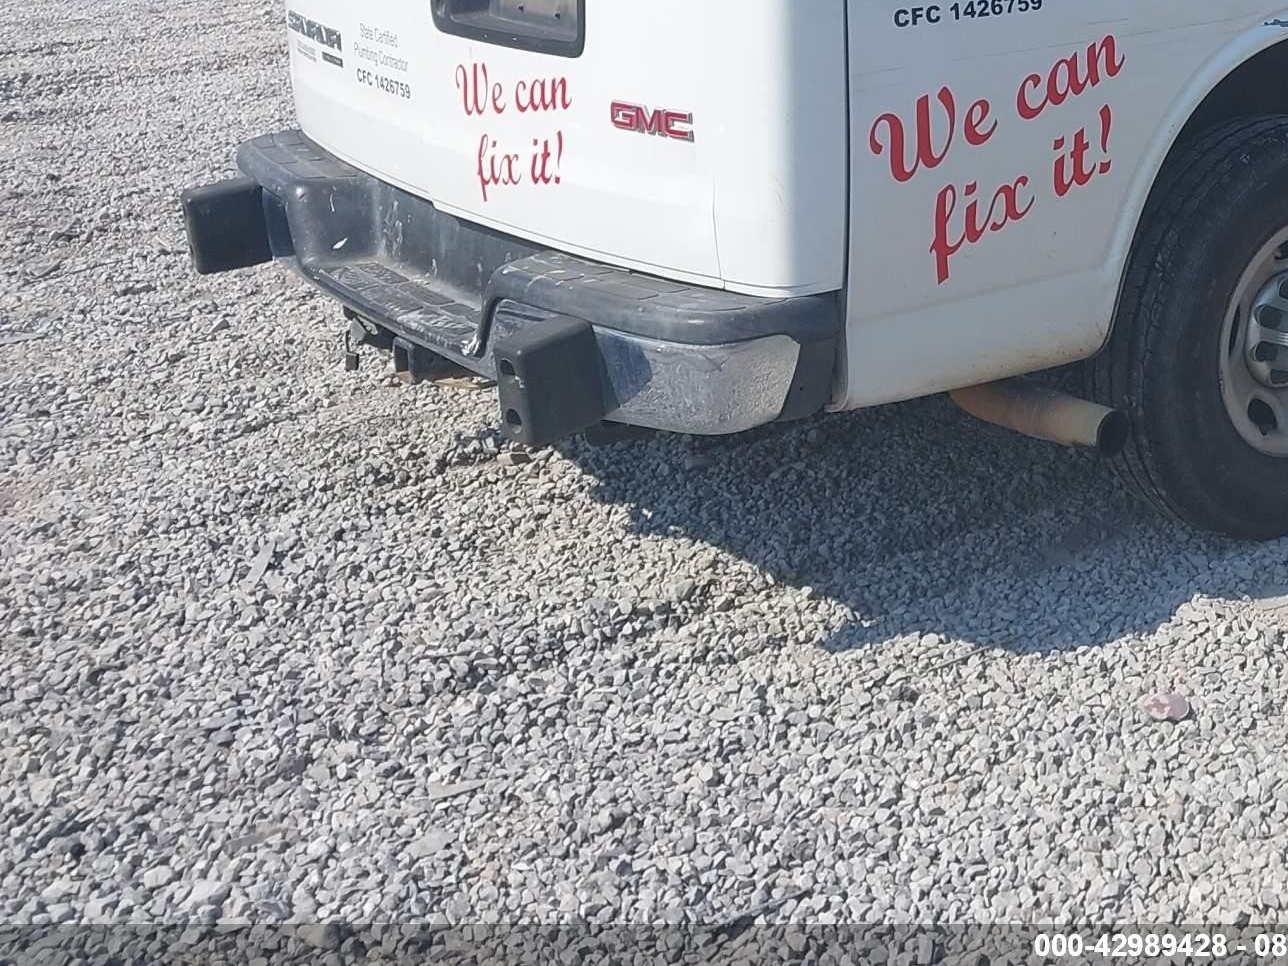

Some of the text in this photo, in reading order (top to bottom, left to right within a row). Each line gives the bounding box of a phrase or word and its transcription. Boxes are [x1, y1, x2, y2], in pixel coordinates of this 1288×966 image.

[894, 5, 941, 27] CFC
[356, 67, 411, 99] CFC 1426759
[456, 63, 572, 115] We can
[869, 34, 1126, 182] We can
[610, 99, 695, 143] GMC
[477, 130, 564, 202] fix it!
[930, 104, 1113, 284] fix it!
